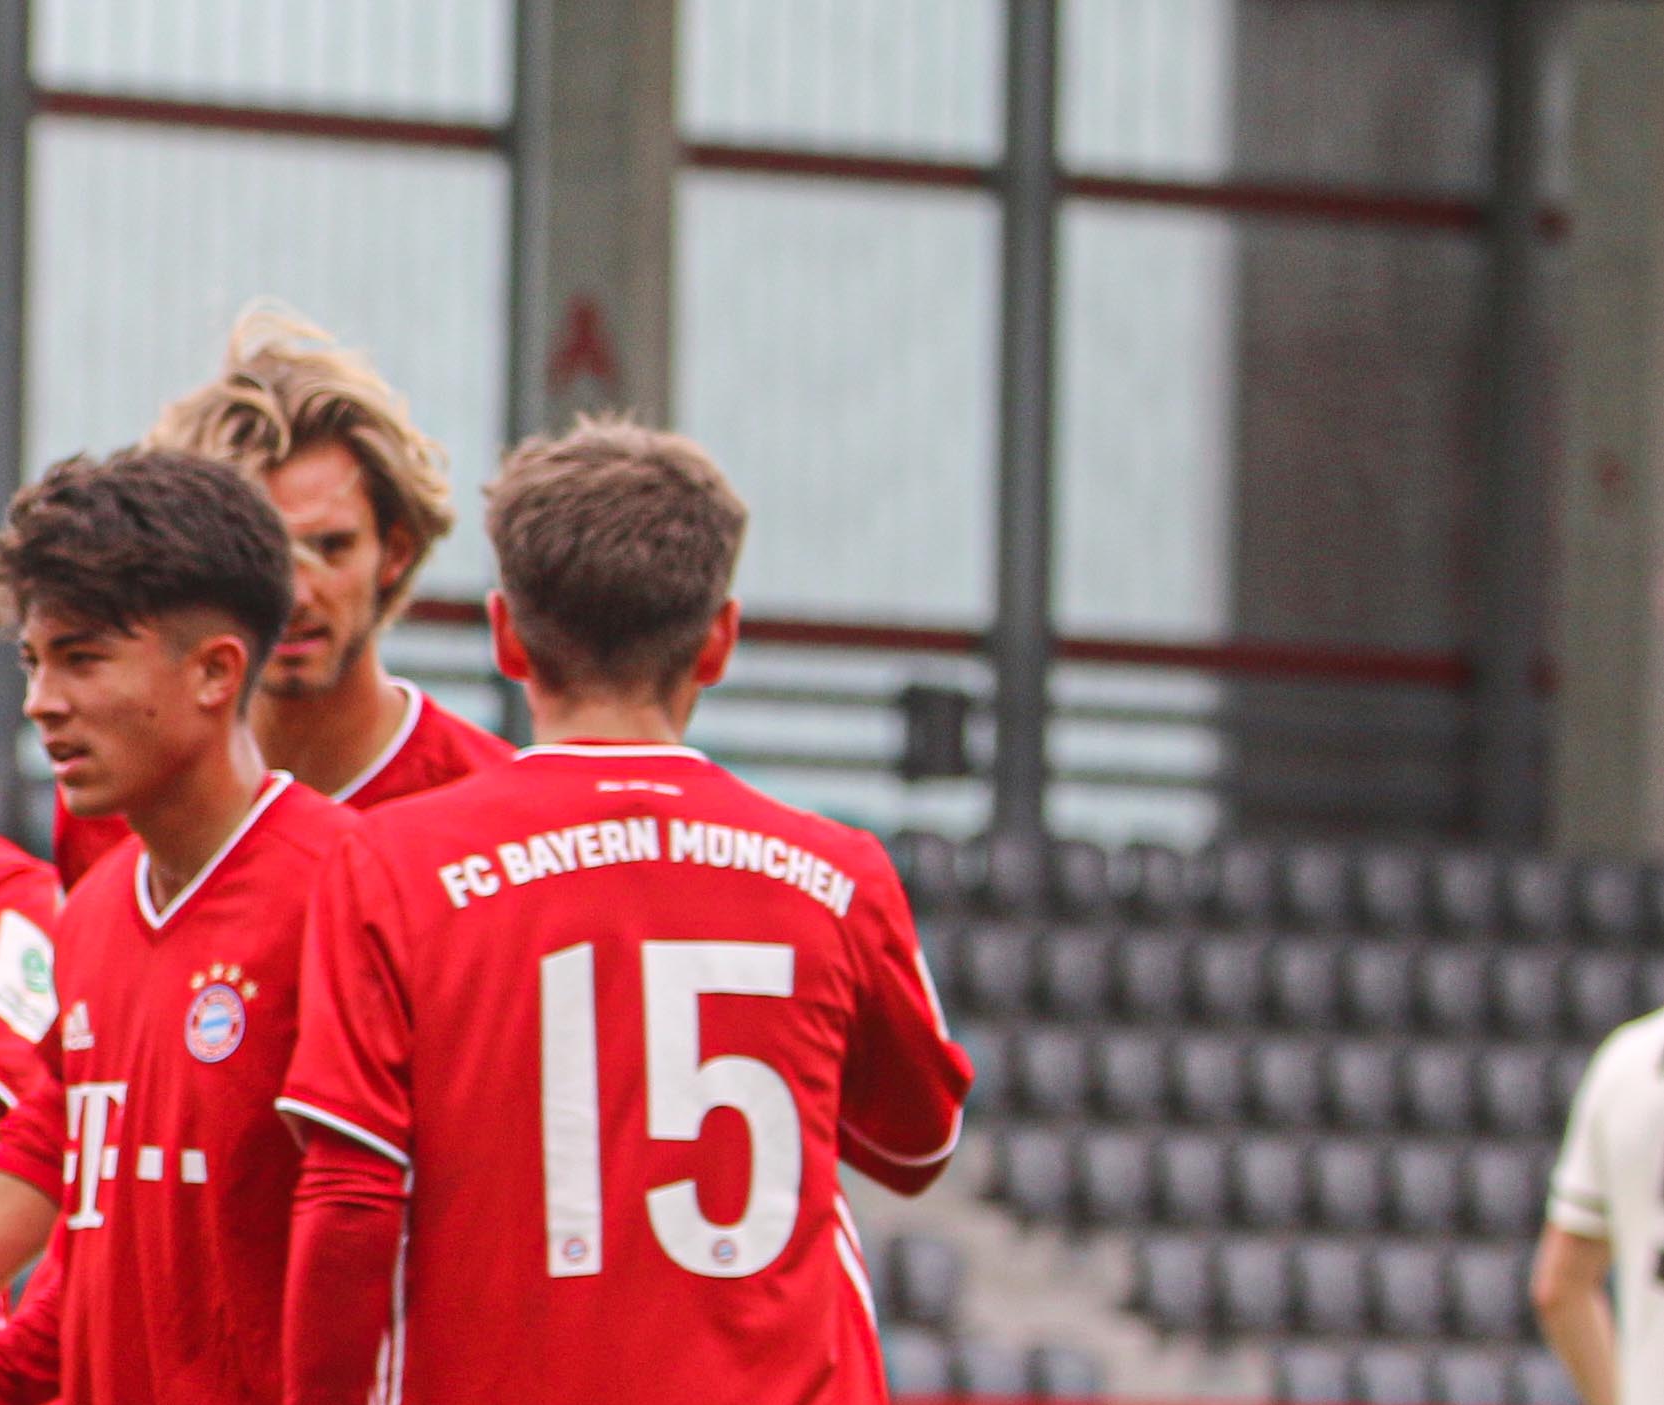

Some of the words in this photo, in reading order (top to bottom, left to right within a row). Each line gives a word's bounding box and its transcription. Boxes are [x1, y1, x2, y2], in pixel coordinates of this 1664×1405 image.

[438, 854, 501, 909] FC
[496, 816, 661, 886] BAYERN
[540, 940, 803, 1279] 15
